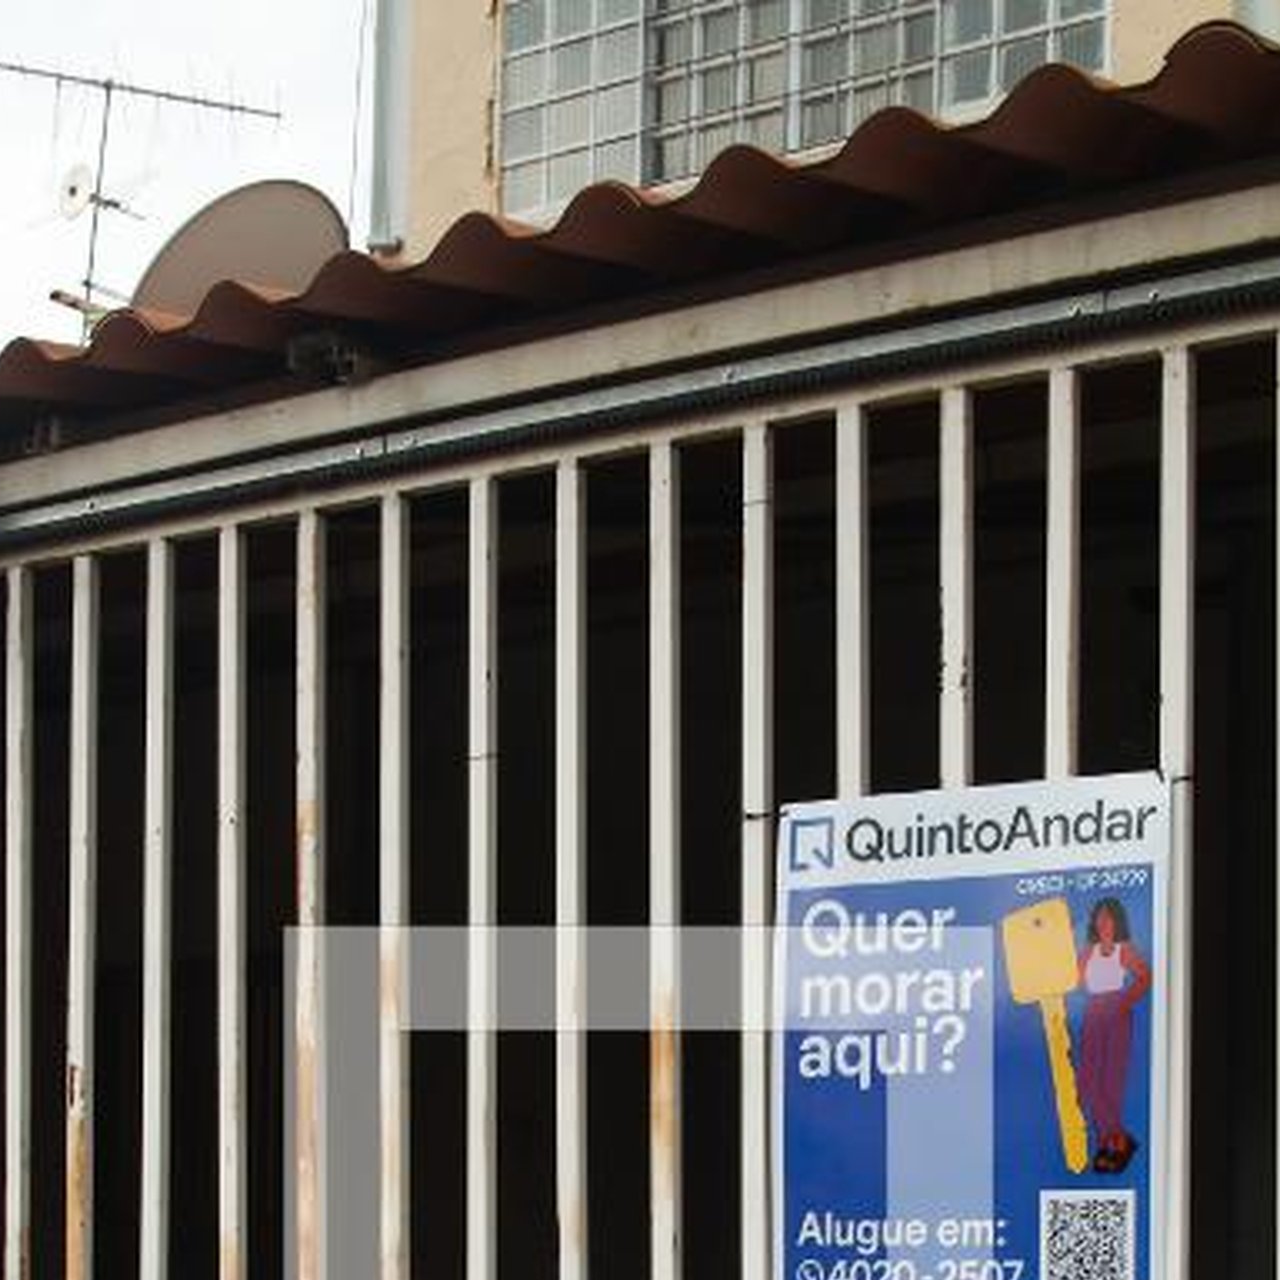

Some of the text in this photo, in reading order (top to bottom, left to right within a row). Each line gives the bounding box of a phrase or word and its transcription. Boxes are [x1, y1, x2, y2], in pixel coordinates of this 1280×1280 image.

[845, 799, 1158, 863] QuintoAndar
[801, 899, 957, 959] Quer
[800, 965, 985, 1019] morar
[798, 1015, 967, 1091] aqui?
[796, 1211, 1006, 1254] Alugue em:
